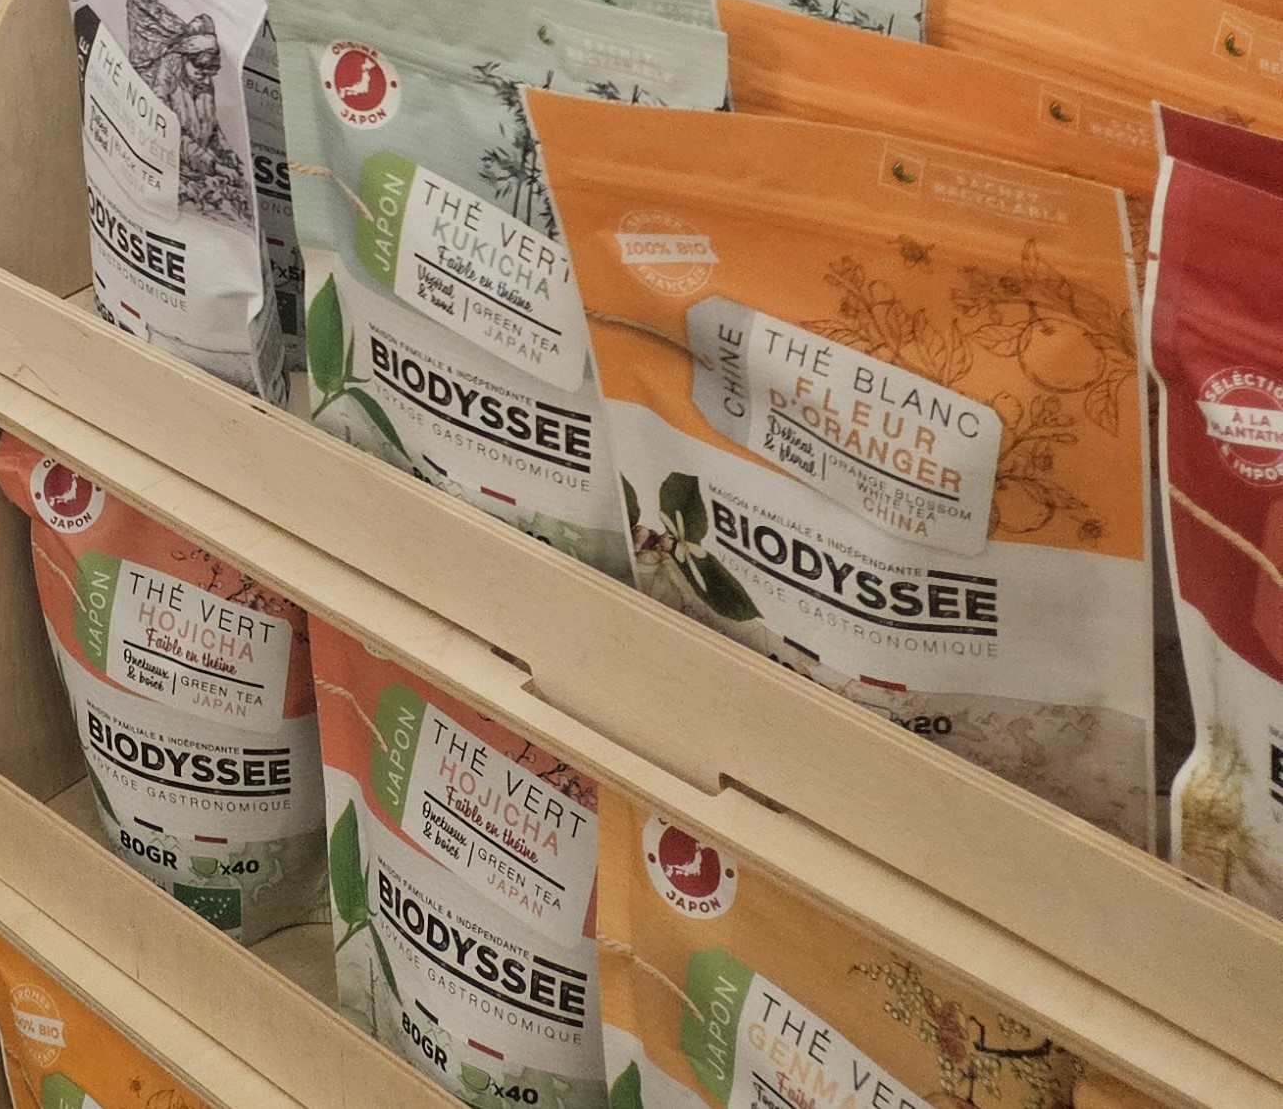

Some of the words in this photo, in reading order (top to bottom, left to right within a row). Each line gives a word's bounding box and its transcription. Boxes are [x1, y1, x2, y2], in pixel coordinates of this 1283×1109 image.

[424, 180, 483, 232] THÉ
[431, 216, 551, 300] KUKICHA
[624, 241, 671, 255] 100%
[676, 242, 707, 256] BIO
[473, 301, 523, 337] GREEN
[532, 331, 560, 356] TEA
[483, 326, 543, 365] JAPAN
[370, 335, 592, 460] BIODYSSEE
[718, 324, 746, 419] CHINE
[764, 328, 831, 378] THÉ
[853, 366, 981, 440] BLANC
[767, 414, 816, 459] Délicat
[768, 385, 962, 492] D'ORANGER
[795, 375, 937, 454] FLEUR
[1250, 412, 1271, 427] LA
[828, 455, 889, 492] ORANGE
[894, 487, 972, 522] BLOSSOM
[855, 480, 903, 512] WHITE
[907, 499, 937, 522] TEA
[863, 495, 931, 538] CHINA
[711, 498, 999, 623] BIODYSSEE
[88, 569, 112, 658] JAPON
[129, 571, 185, 612] THÉ
[200, 599, 277, 643] VERT
[137, 602, 255, 663] HOJICHA
[717, 549, 787, 604] VOYAGE
[798, 600, 1000, 659] GASTRONOMIQUE
[123, 648, 170, 680] Onctueux
[127, 666, 137, 680] &
[138, 670, 166, 692] boisé
[146, 628, 183, 658] Faible
[185, 649, 199, 663] en
[202, 652, 238, 676] théine
[180, 675, 229, 698] GREEN
[236, 690, 264, 706] TEA
[192, 694, 248, 717] JAPAN
[88, 710, 291, 787] BIODYSSEE
[385, 706, 417, 806] JAPON
[433, 718, 488, 777] THÉ
[506, 770, 587, 839] VERT
[92, 753, 138, 791] VOYAGE
[146, 786, 292, 813] GASTRONOMIQUE
[438, 755, 559, 857] HOJICHA
[119, 829, 178, 871] 80GR
[422, 801, 468, 847] Onctueux
[423, 824, 433, 839] &
[434, 833, 460, 861] boisé
[446, 785, 483, 827] Faible
[485, 820, 500, 838] en
[502, 828, 539, 864] théine
[221, 859, 260, 876] x40
[478, 848, 526, 888] GREEN
[534, 883, 562, 910] TEA
[486, 873, 544, 919] JAPAN
[378, 870, 587, 1017] BIODYSSEE
[379, 916, 421, 970] VOYAGE
[427, 968, 583, 1046] GASTRONOMIQUE
[38, 1023, 59, 1039] BIO
[401, 1012, 448, 1073] 80GR
[707, 975, 739, 1081] JAPON
[494, 1083, 539, 1106] x40
